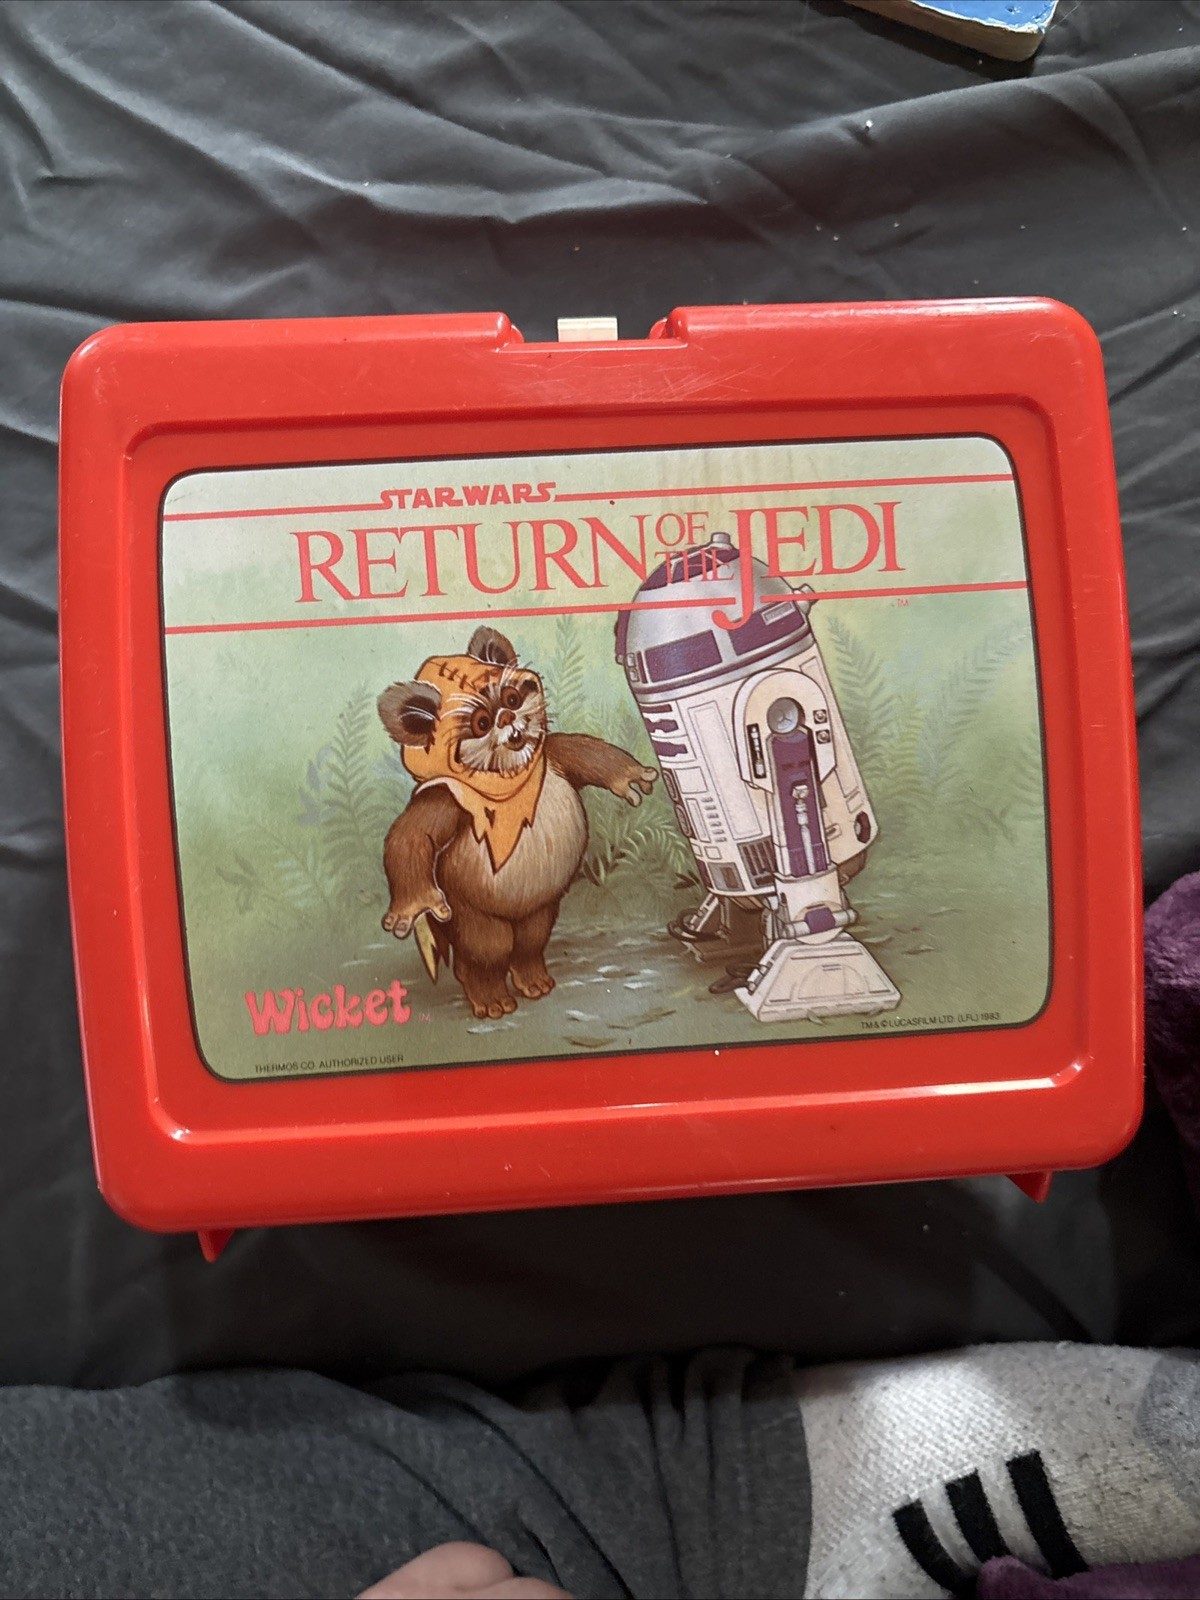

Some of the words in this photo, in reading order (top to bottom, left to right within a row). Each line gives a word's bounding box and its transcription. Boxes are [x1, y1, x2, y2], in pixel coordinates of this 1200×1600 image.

[380, 487, 463, 510] STAR
[462, 481, 556, 506] WARS
[655, 510, 709, 547] OF
[290, 514, 652, 603] RETURN
[654, 548, 735, 584] THE
[711, 501, 906, 631] JEDI
[244, 979, 412, 1036] Wicket
[980, 1010, 1000, 1022] 1983
[255, 1061, 299, 1074] THERMOS
[319, 1056, 378, 1069] AUTHORIZED
[379, 1054, 405, 1065] USER
